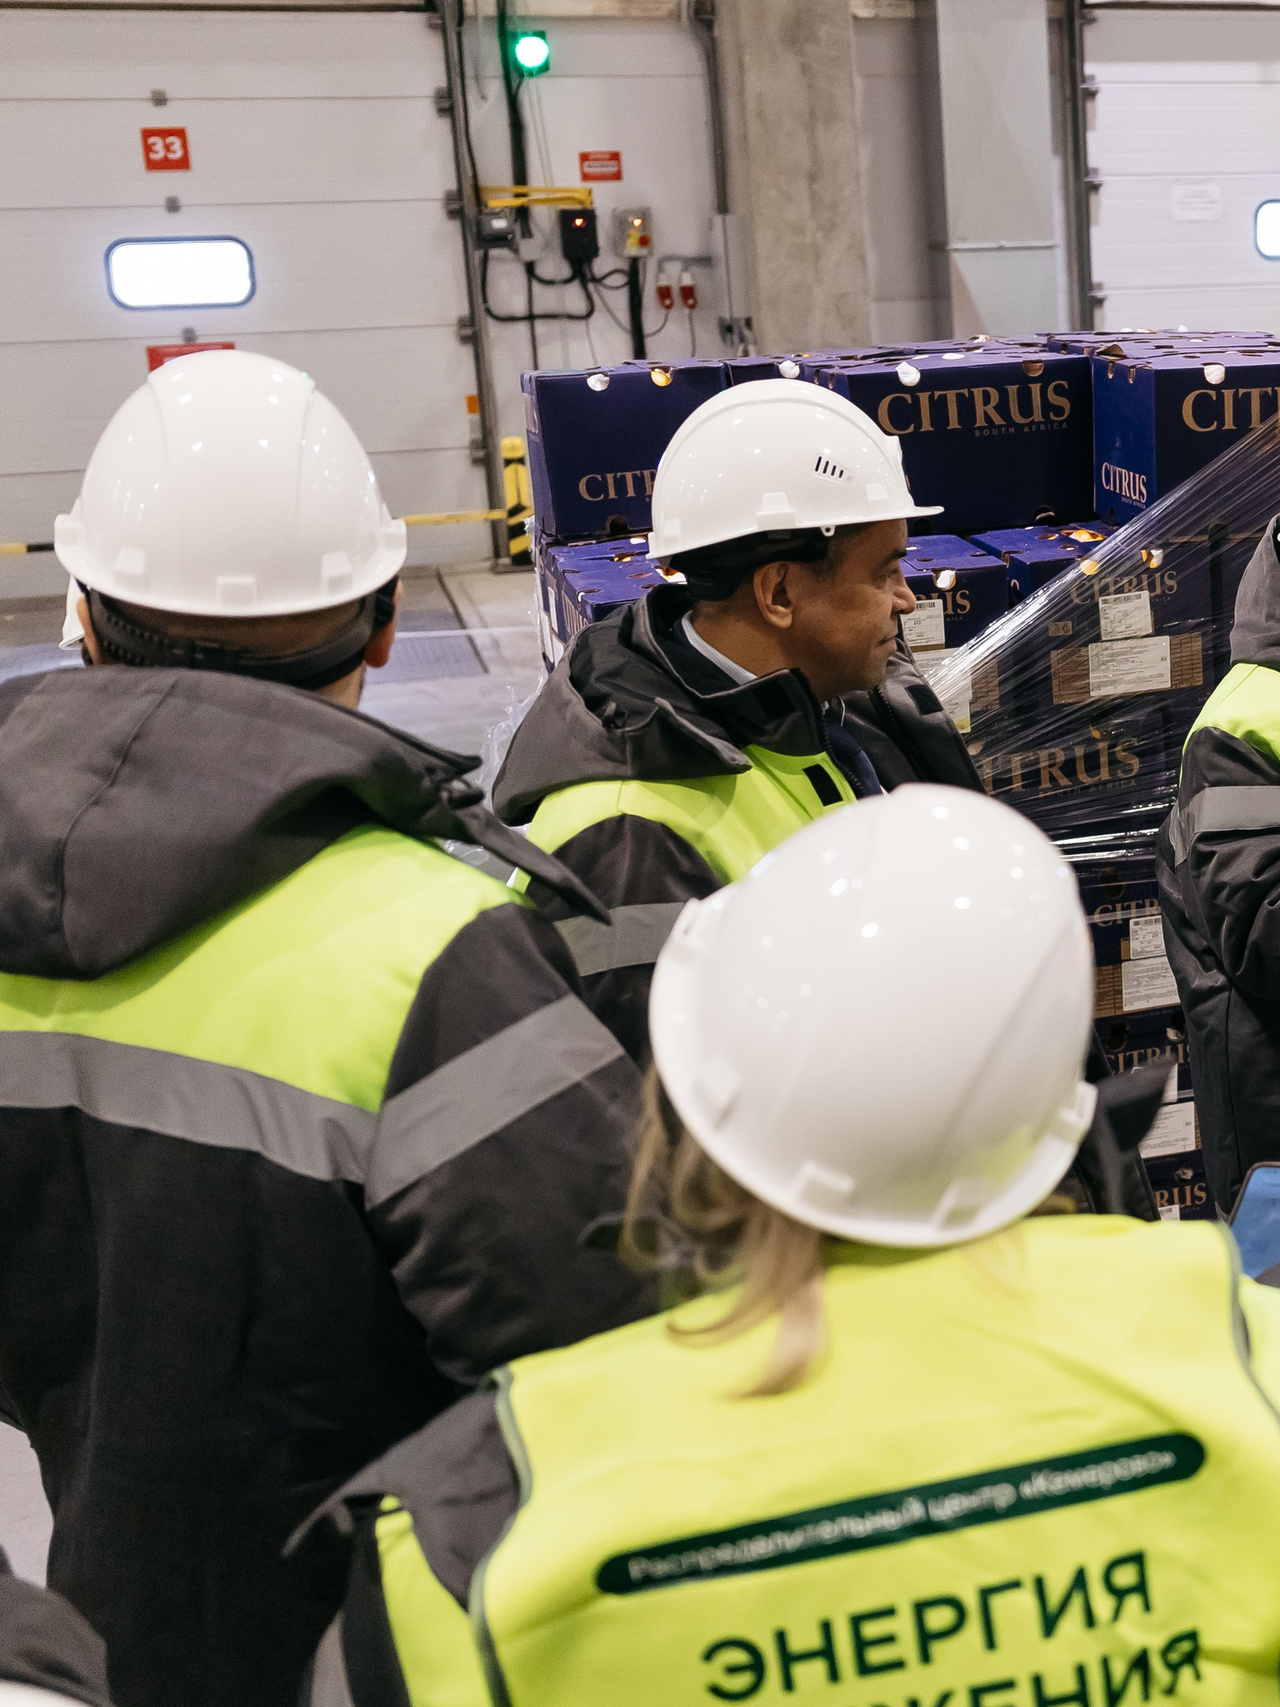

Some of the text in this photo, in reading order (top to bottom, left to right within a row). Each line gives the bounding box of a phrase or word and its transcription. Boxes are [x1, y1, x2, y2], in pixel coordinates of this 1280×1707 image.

[147, 136, 184, 160] 33
[877, 380, 1071, 435] CITRUS
[974, 422, 1068, 438] SOUTH AFRICA
[1101, 462, 1147, 503] CITRUS
[983, 737, 1140, 796] ITRUS
[1094, 898, 1159, 927] CITR
[1155, 1182, 1207, 1208] RUS
[702, 1550, 1152, 1702] ЭНЕРГИЯ
